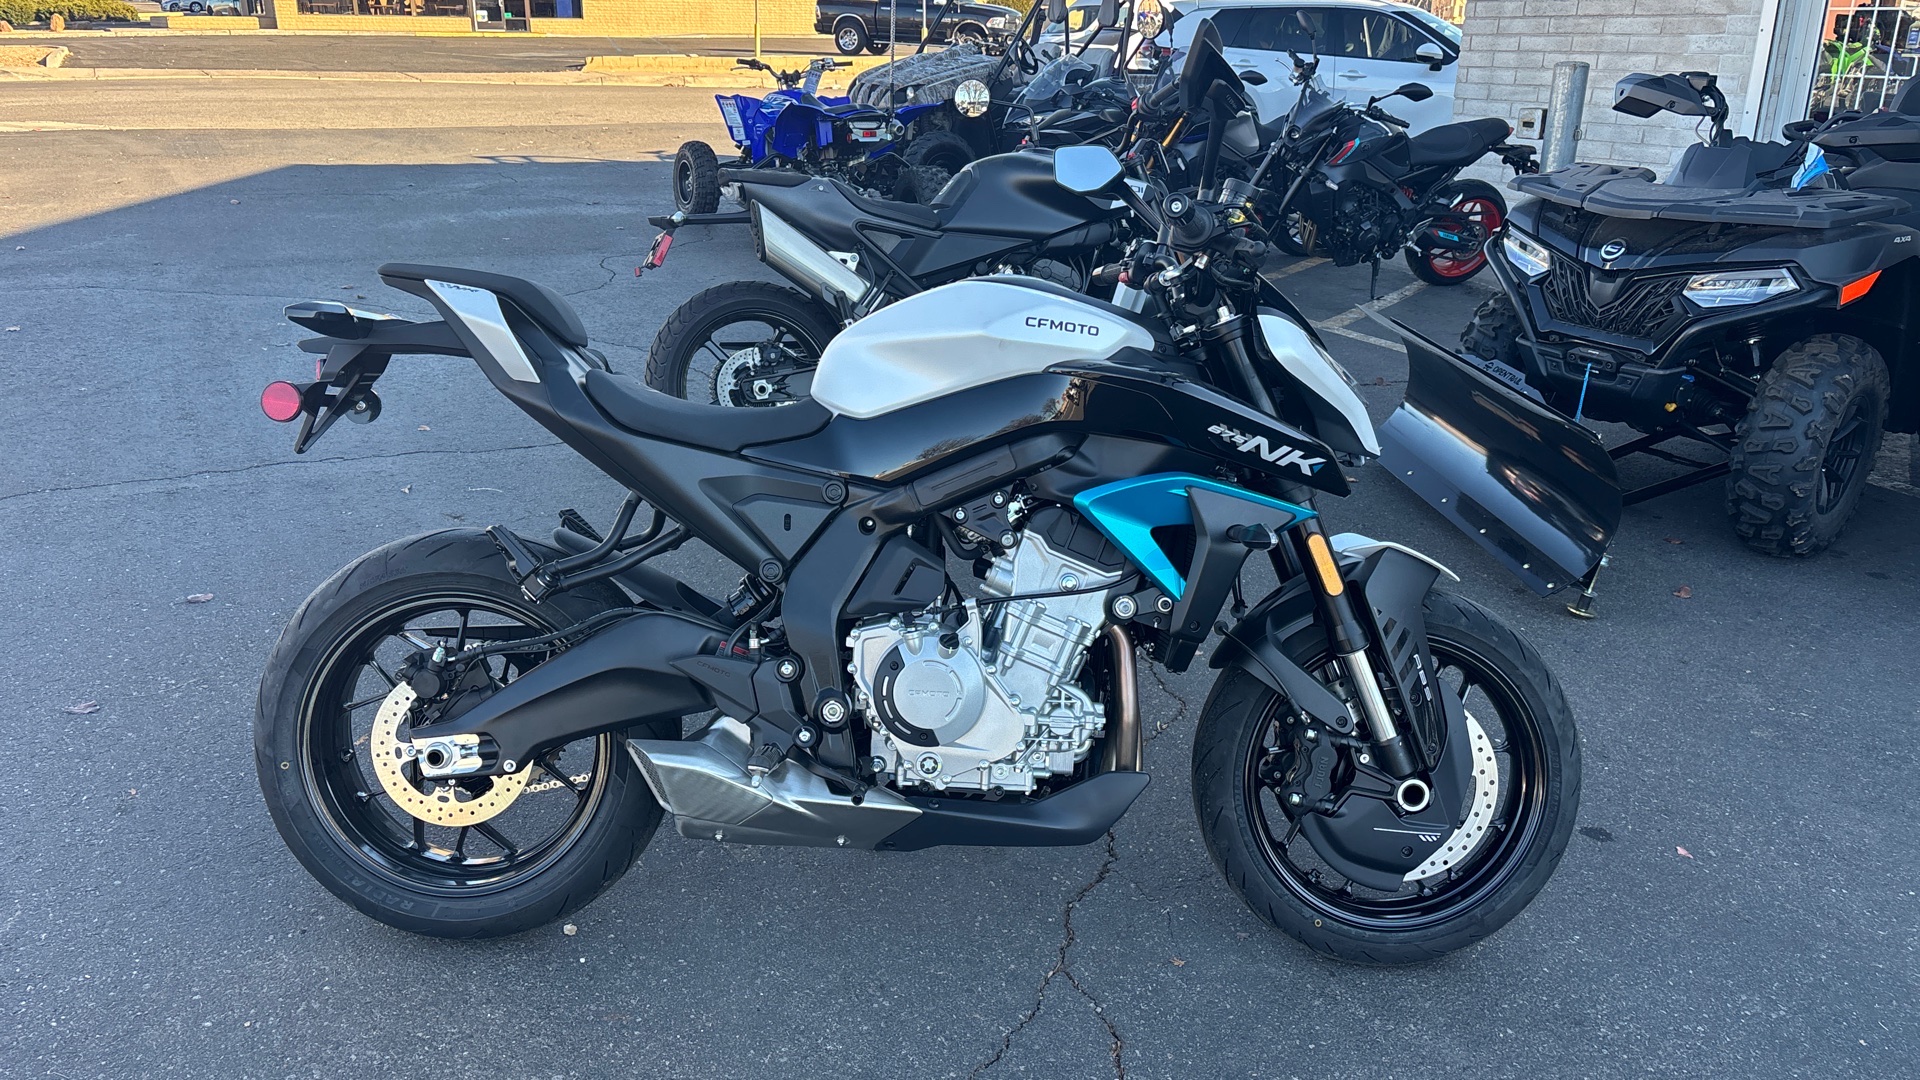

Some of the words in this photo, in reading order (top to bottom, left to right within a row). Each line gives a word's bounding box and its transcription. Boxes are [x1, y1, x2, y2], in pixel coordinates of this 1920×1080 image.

[1025, 316, 1100, 337] CFMOTO
[1492, 365, 1523, 386] OPENTRAIL
[1207, 424, 1249, 444] 675
[1236, 435, 1327, 476] NK
[696, 660, 731, 678] CFMOTO
[1412, 653, 1433, 702] ABS
[343, 871, 414, 911] RADIAL
